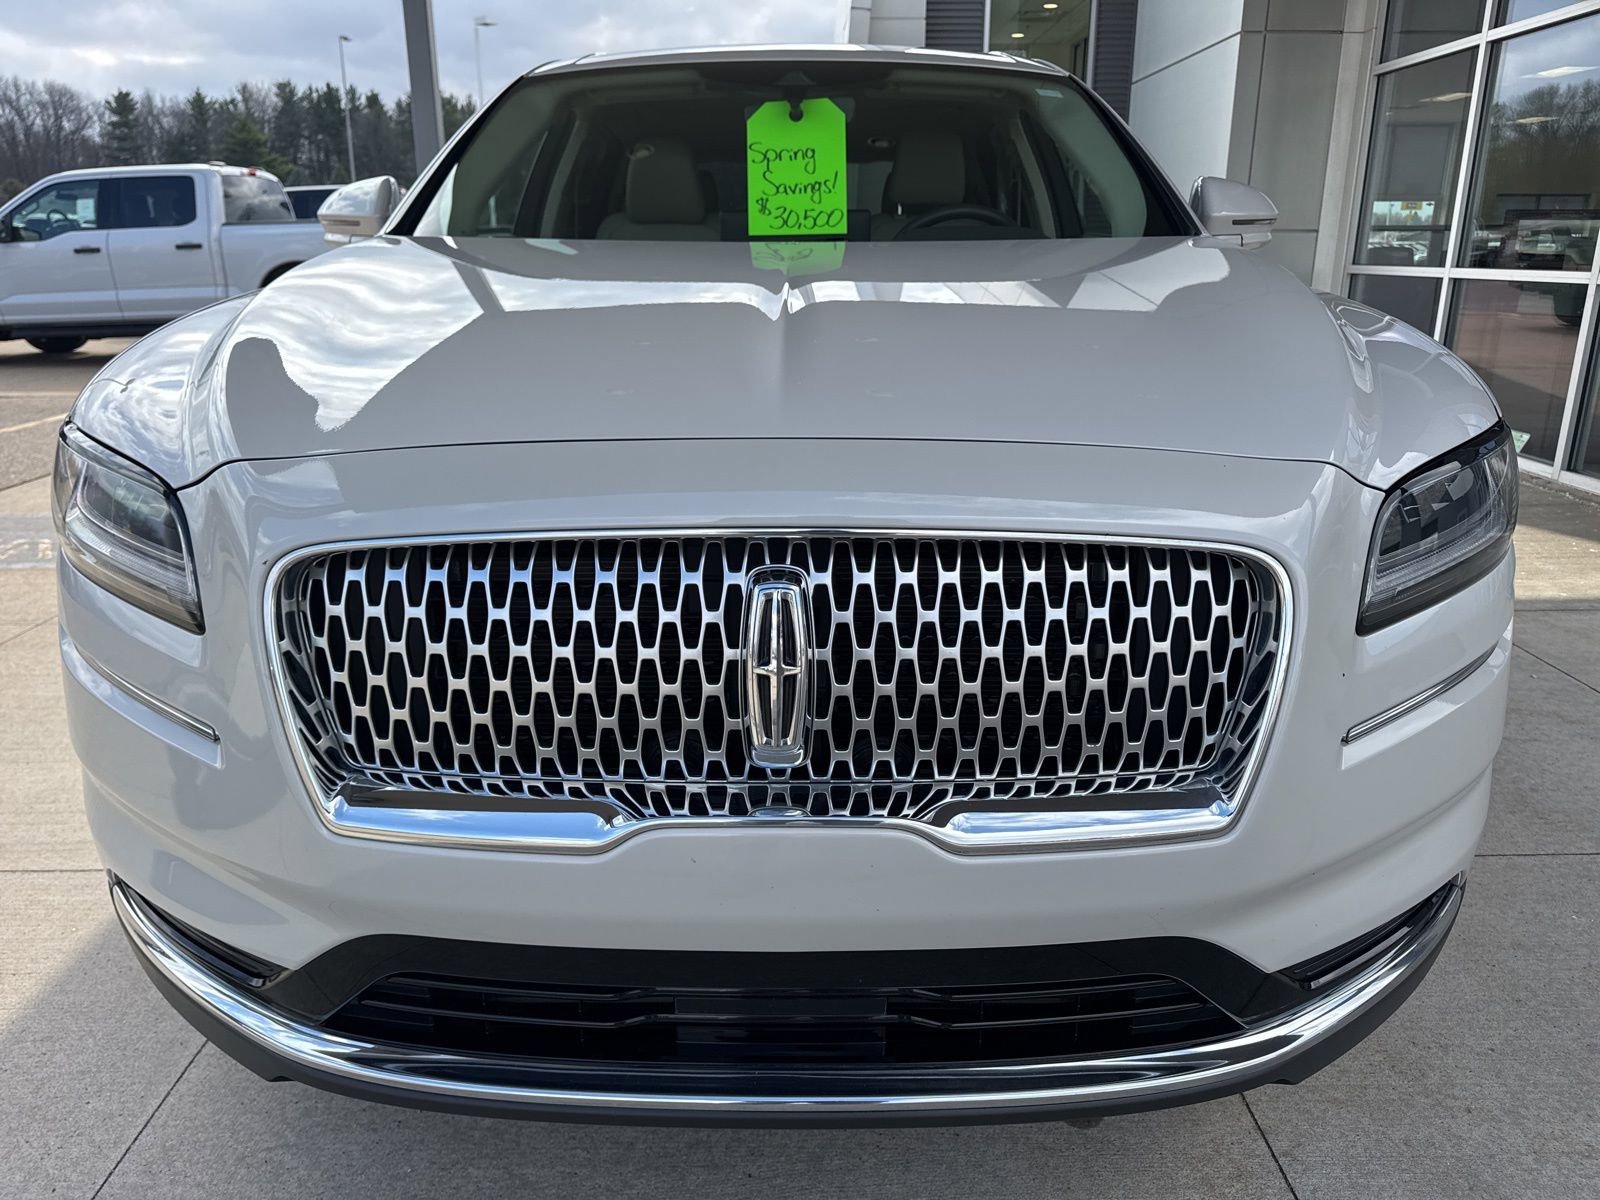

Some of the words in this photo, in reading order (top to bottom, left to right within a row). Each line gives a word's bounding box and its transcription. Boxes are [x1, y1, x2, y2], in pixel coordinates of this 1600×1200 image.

[749, 142, 816, 175] Spring
[762, 170, 838, 204] Savings!
[756, 197, 844, 230] $30,500
